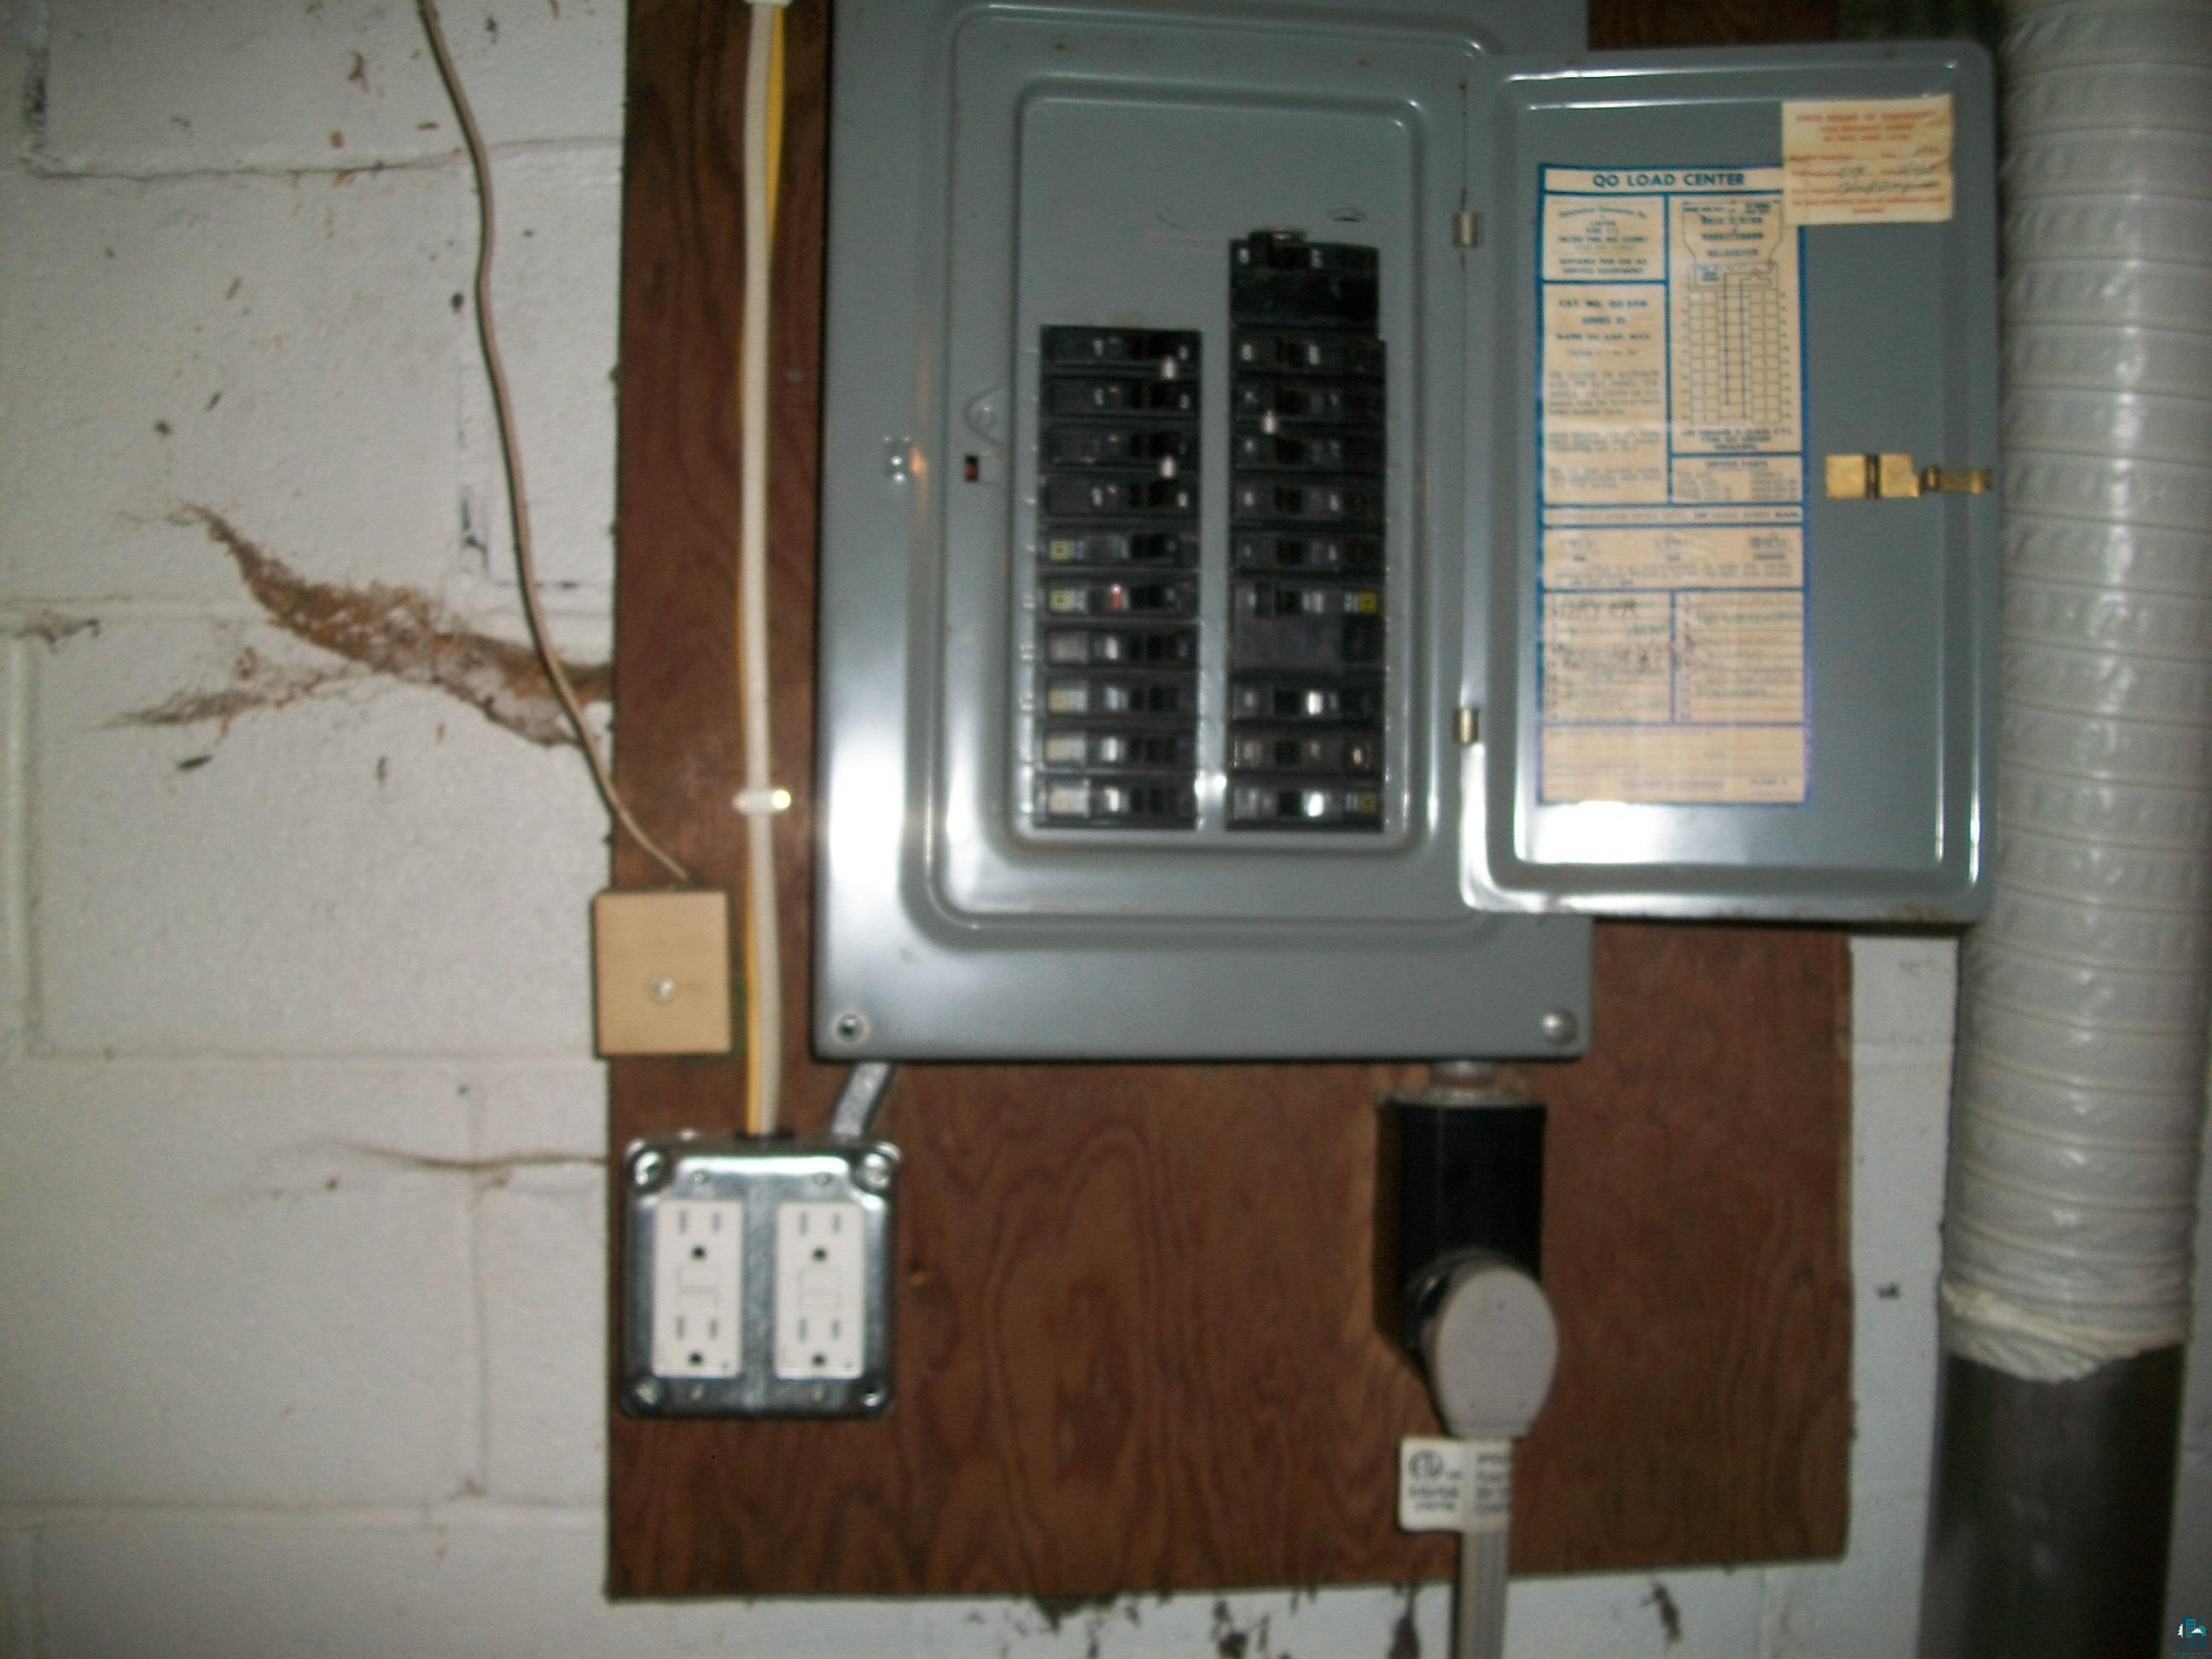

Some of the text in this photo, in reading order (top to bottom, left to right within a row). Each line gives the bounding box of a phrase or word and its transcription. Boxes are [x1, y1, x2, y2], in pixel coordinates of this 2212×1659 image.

[1592, 172, 1745, 188] QO LOAD CENTER
